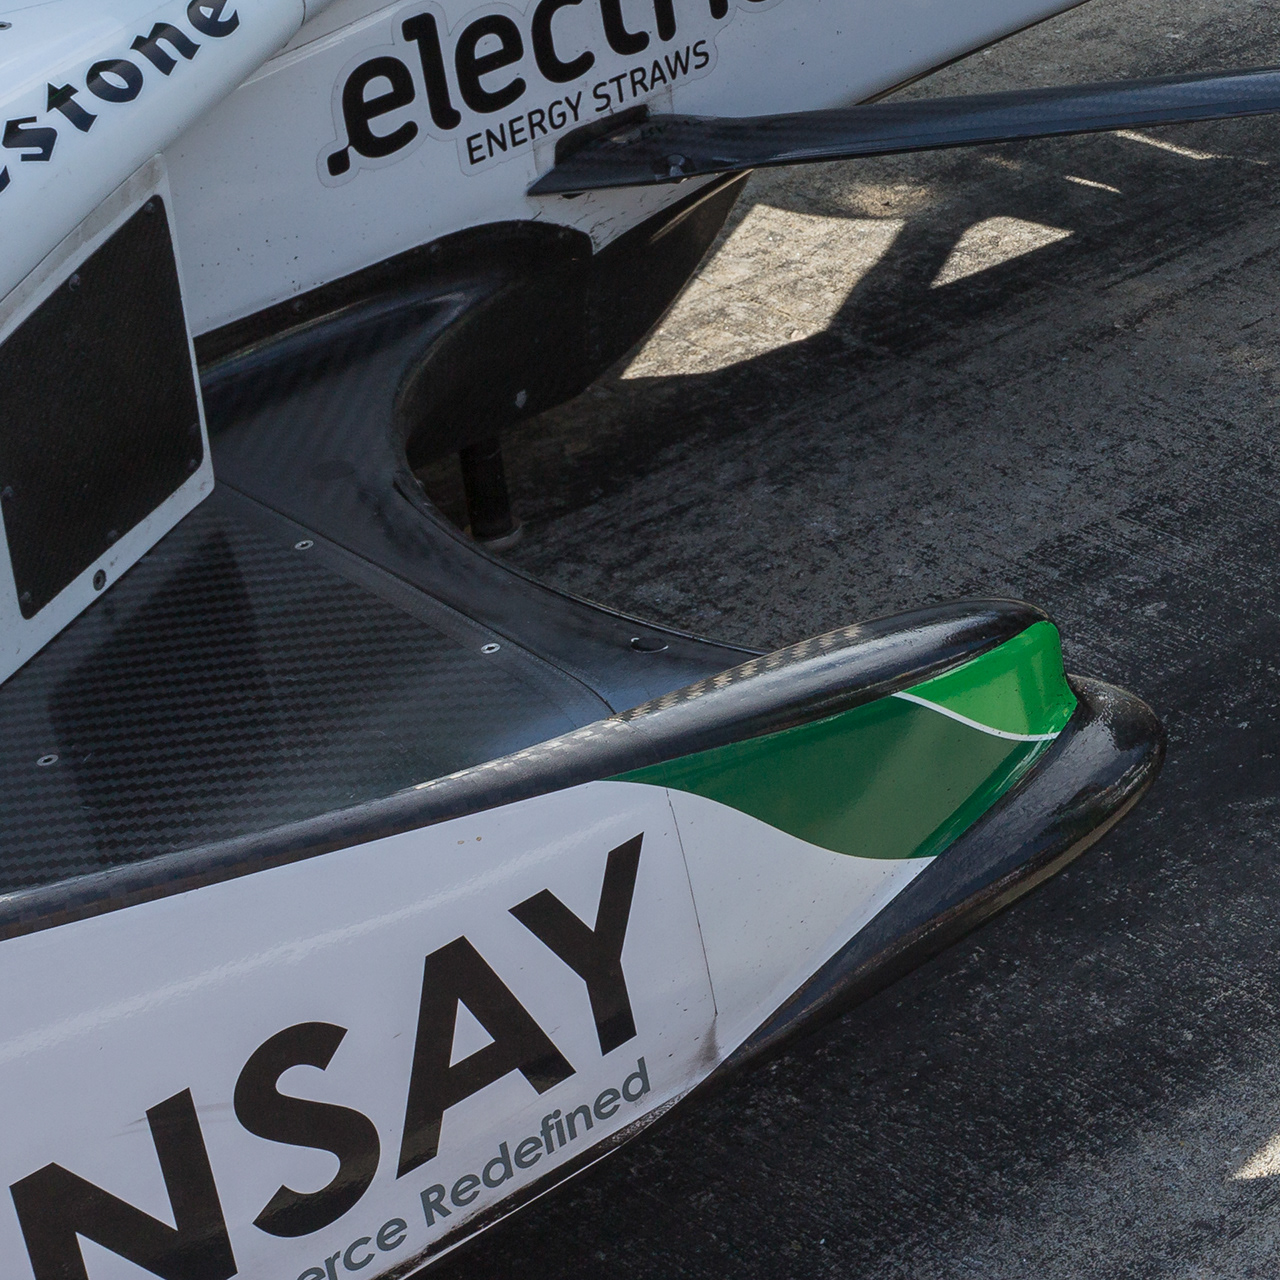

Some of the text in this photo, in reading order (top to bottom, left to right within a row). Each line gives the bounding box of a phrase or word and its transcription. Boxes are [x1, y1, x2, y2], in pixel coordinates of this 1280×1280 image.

[466, 40, 711, 166] ENERGY STRAWS
[419, 1056, 652, 1222] Redefined
